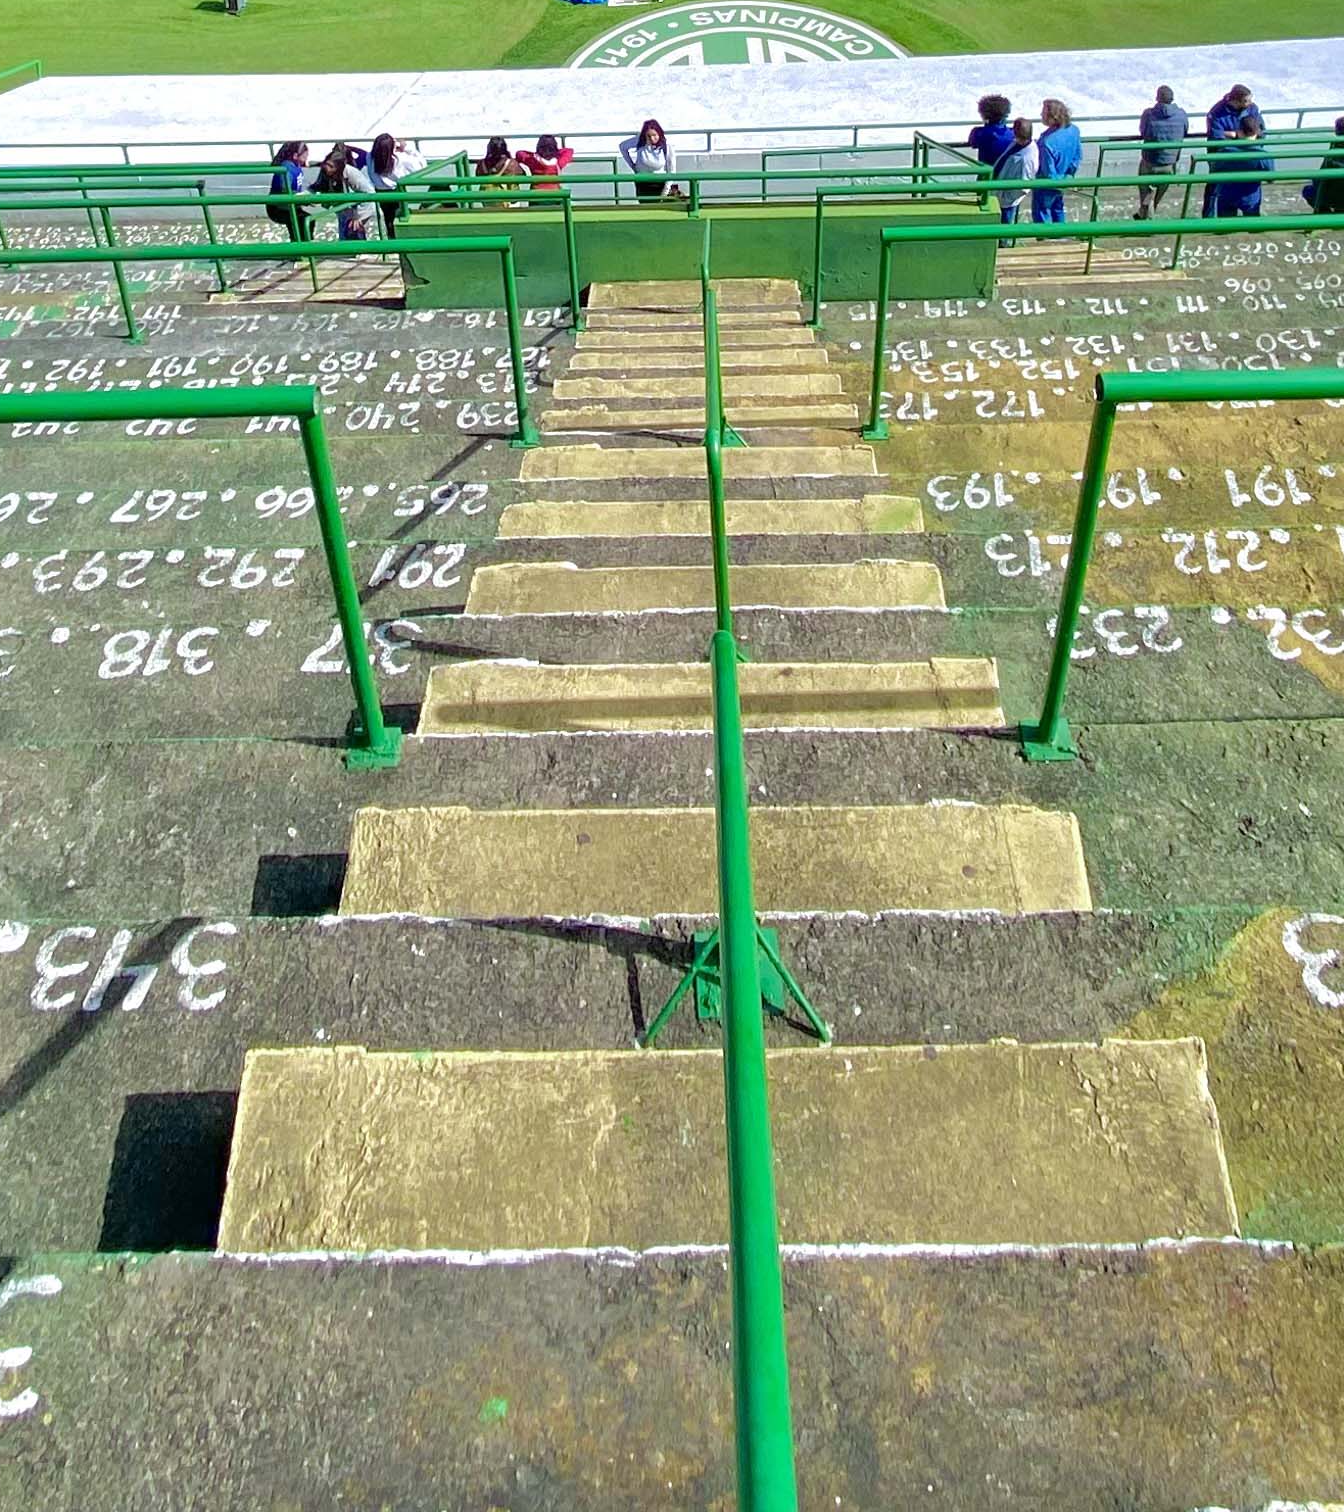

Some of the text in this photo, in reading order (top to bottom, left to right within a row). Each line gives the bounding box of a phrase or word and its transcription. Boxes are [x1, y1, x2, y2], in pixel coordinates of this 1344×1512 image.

[595, 9, 875, 66] CAMPINAS 1911
[1002, 294, 1287, 316] 110 111 112 113
[968, 338, 1032, 360] 133
[1065, 335, 1125, 355] 132
[1166, 332, 1217, 353] 131
[1256, 329, 1321, 353] 130
[45, 359, 106, 381] 192
[146, 357, 197, 377] 191
[230, 354, 288, 376] 190
[318, 350, 378, 372] 189
[415, 348, 475, 371] 188
[911, 360, 980, 383] 153
[1015, 358, 1080, 380] 152
[384, 371, 447, 394] 214
[345, 401, 519, 431] 239 240
[972, 390, 1045, 418] 172
[394, 481, 488, 517] 265
[926, 472, 1014, 511] 193
[1225, 466, 1311, 507] 191
[109, 489, 208, 524] 267
[1161, 529, 1267, 574] 212
[32, 548, 154, 592] 293
[198, 547, 305, 590] 292
[368, 543, 467, 589] 291
[98, 625, 219, 679] 318
[30, 921, 237, 1012] 343
